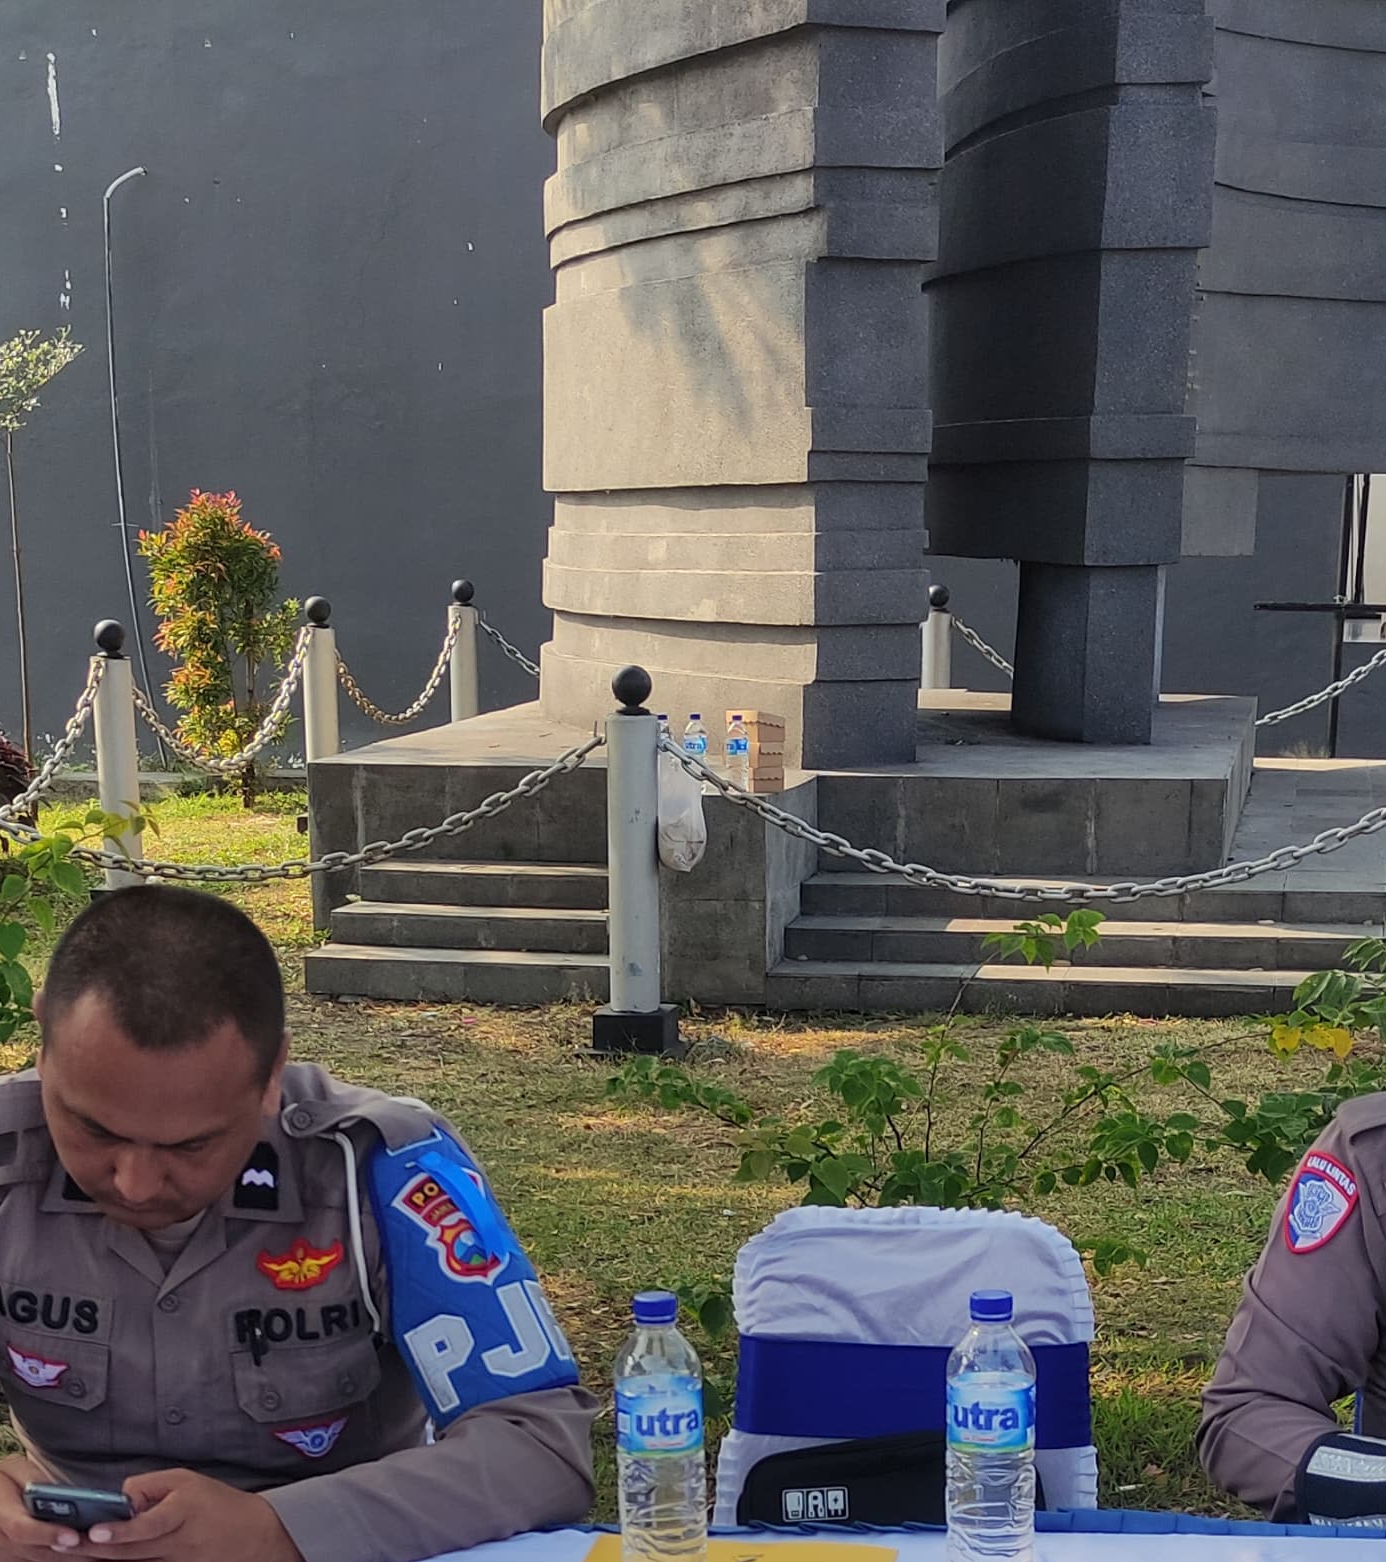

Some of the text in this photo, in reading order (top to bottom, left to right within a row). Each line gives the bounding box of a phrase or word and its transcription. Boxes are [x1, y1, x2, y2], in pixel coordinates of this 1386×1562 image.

[235, 1302, 360, 1344] POLRI
[635, 1407, 699, 1437] utra
[953, 1400, 1019, 1431] utra
